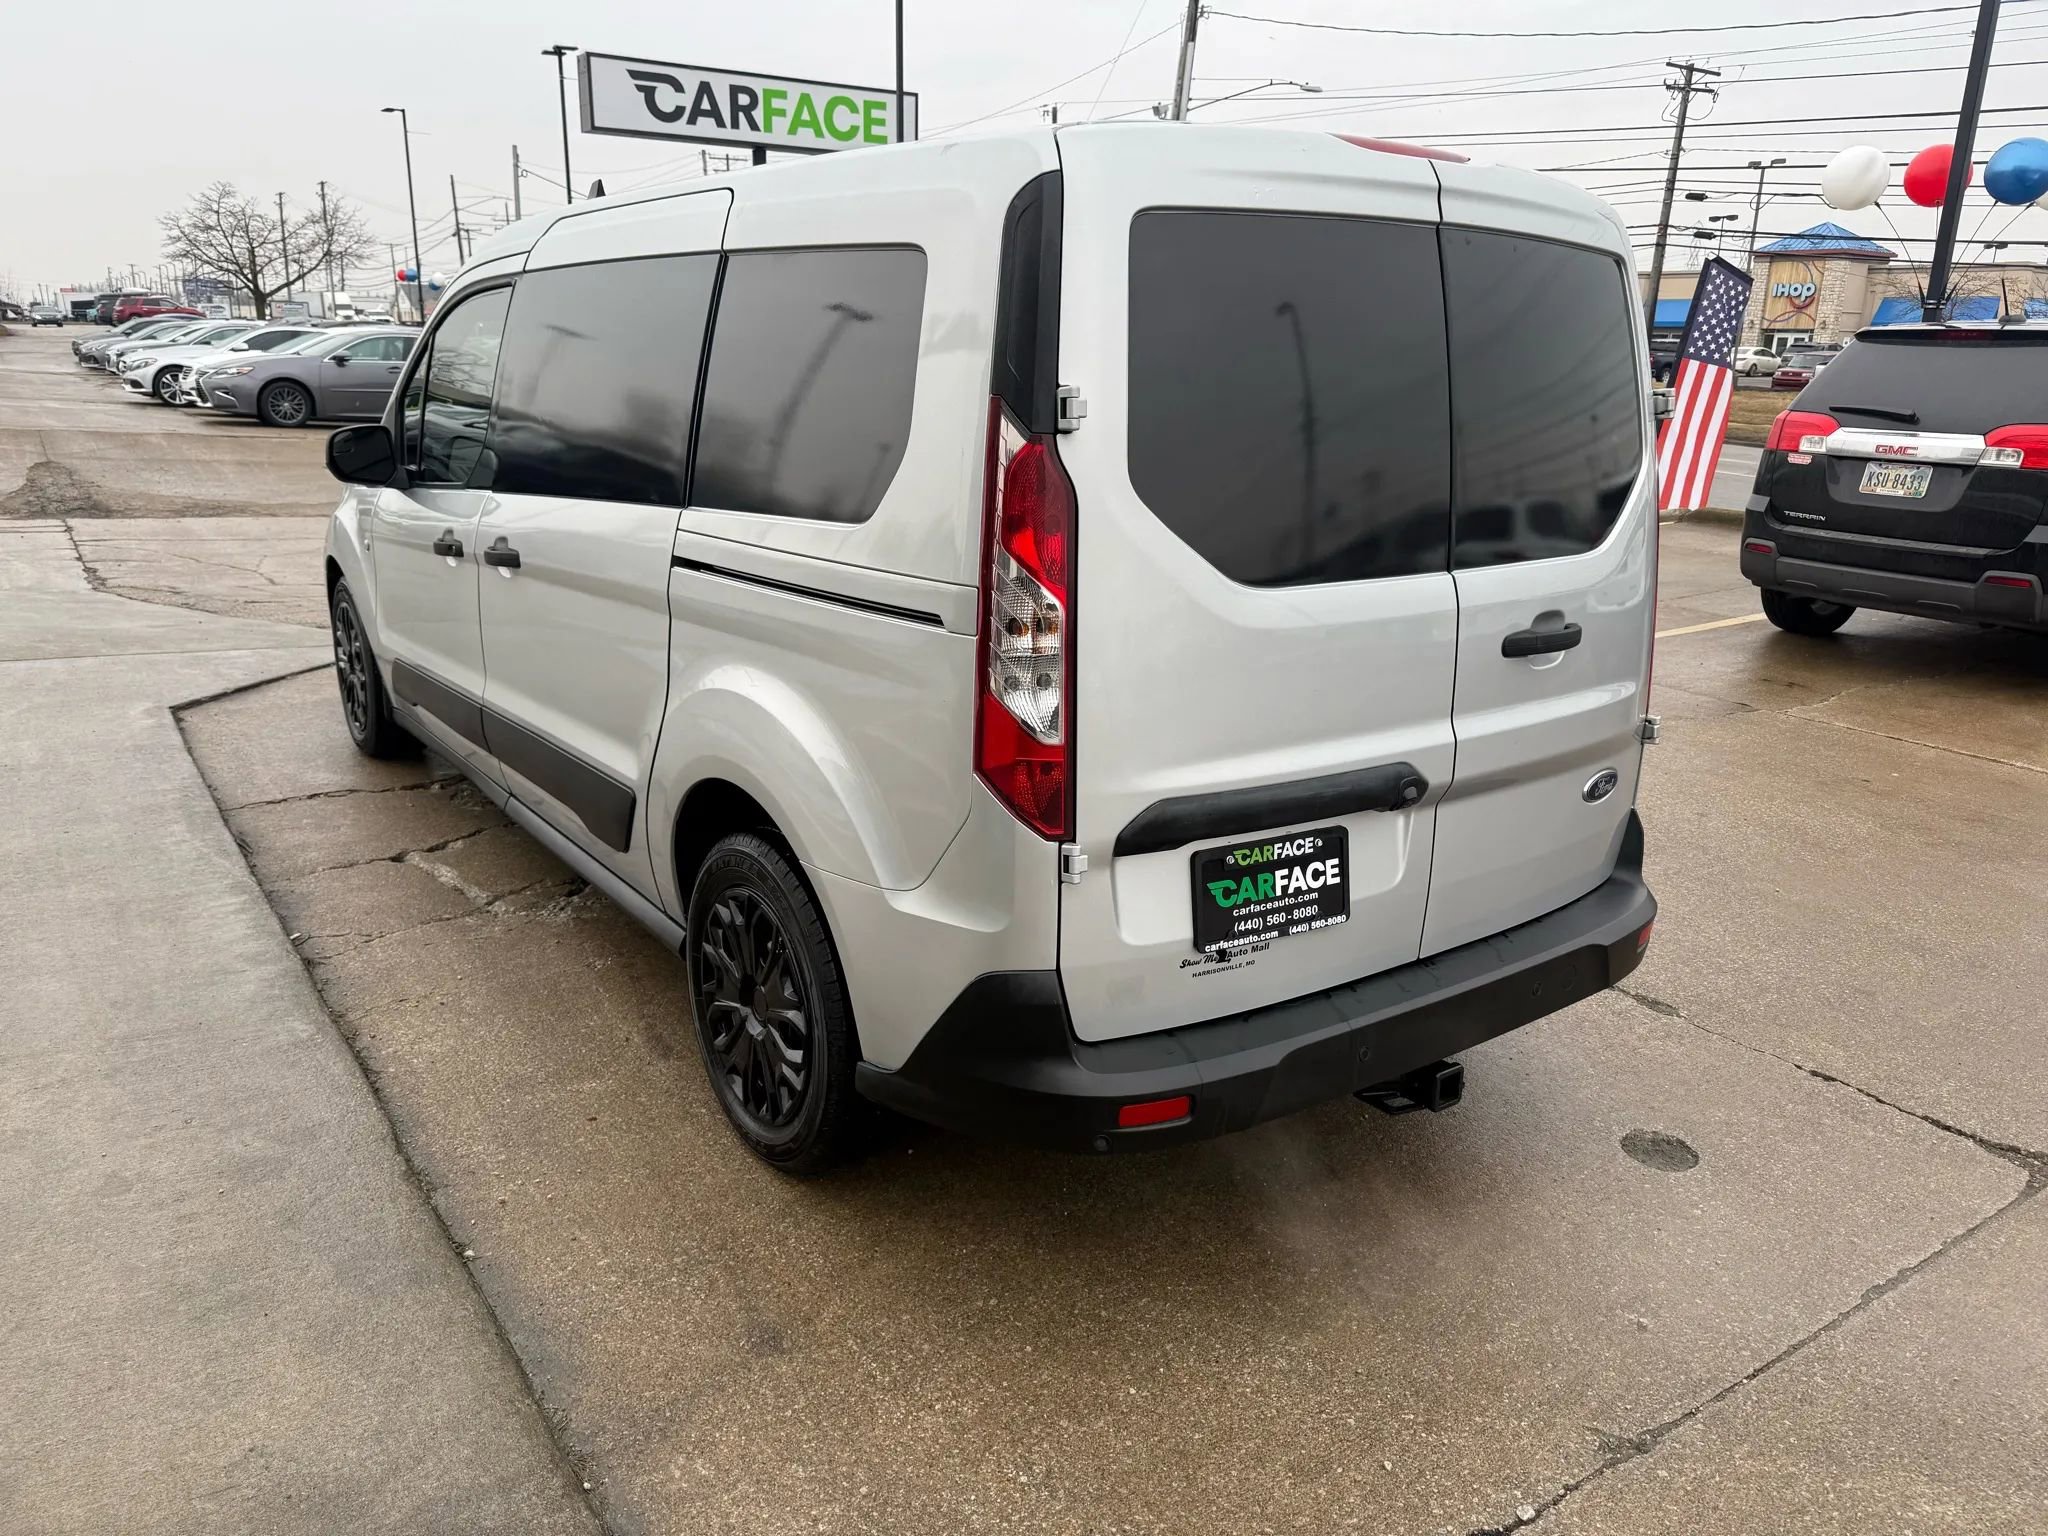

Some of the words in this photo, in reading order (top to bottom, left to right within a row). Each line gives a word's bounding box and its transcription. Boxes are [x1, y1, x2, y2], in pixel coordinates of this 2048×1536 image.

[626, 69, 888, 144] CARFACE
[1875, 444, 1918, 456] GMC
[1784, 510, 1826, 521] TERRAIN
[1233, 837, 1314, 866] CARFACE
[1206, 858, 1340, 908] CARFACE
[1233, 892, 1319, 916] carfaceauto.com
[1204, 930, 1279, 952] carfaceauto.com
[1289, 923, 1309, 935] (440)
[1311, 914, 1347, 929] 560-8080
[1234, 917, 1263, 933] (440)
[1180, 958, 1202, 969] Show
[1226, 948, 1248, 959] Auto
[1251, 942, 1270, 953] Mall
[1192, 962, 1245, 978] HARRISONVILLE,
[1245, 959, 1255, 967] MO
